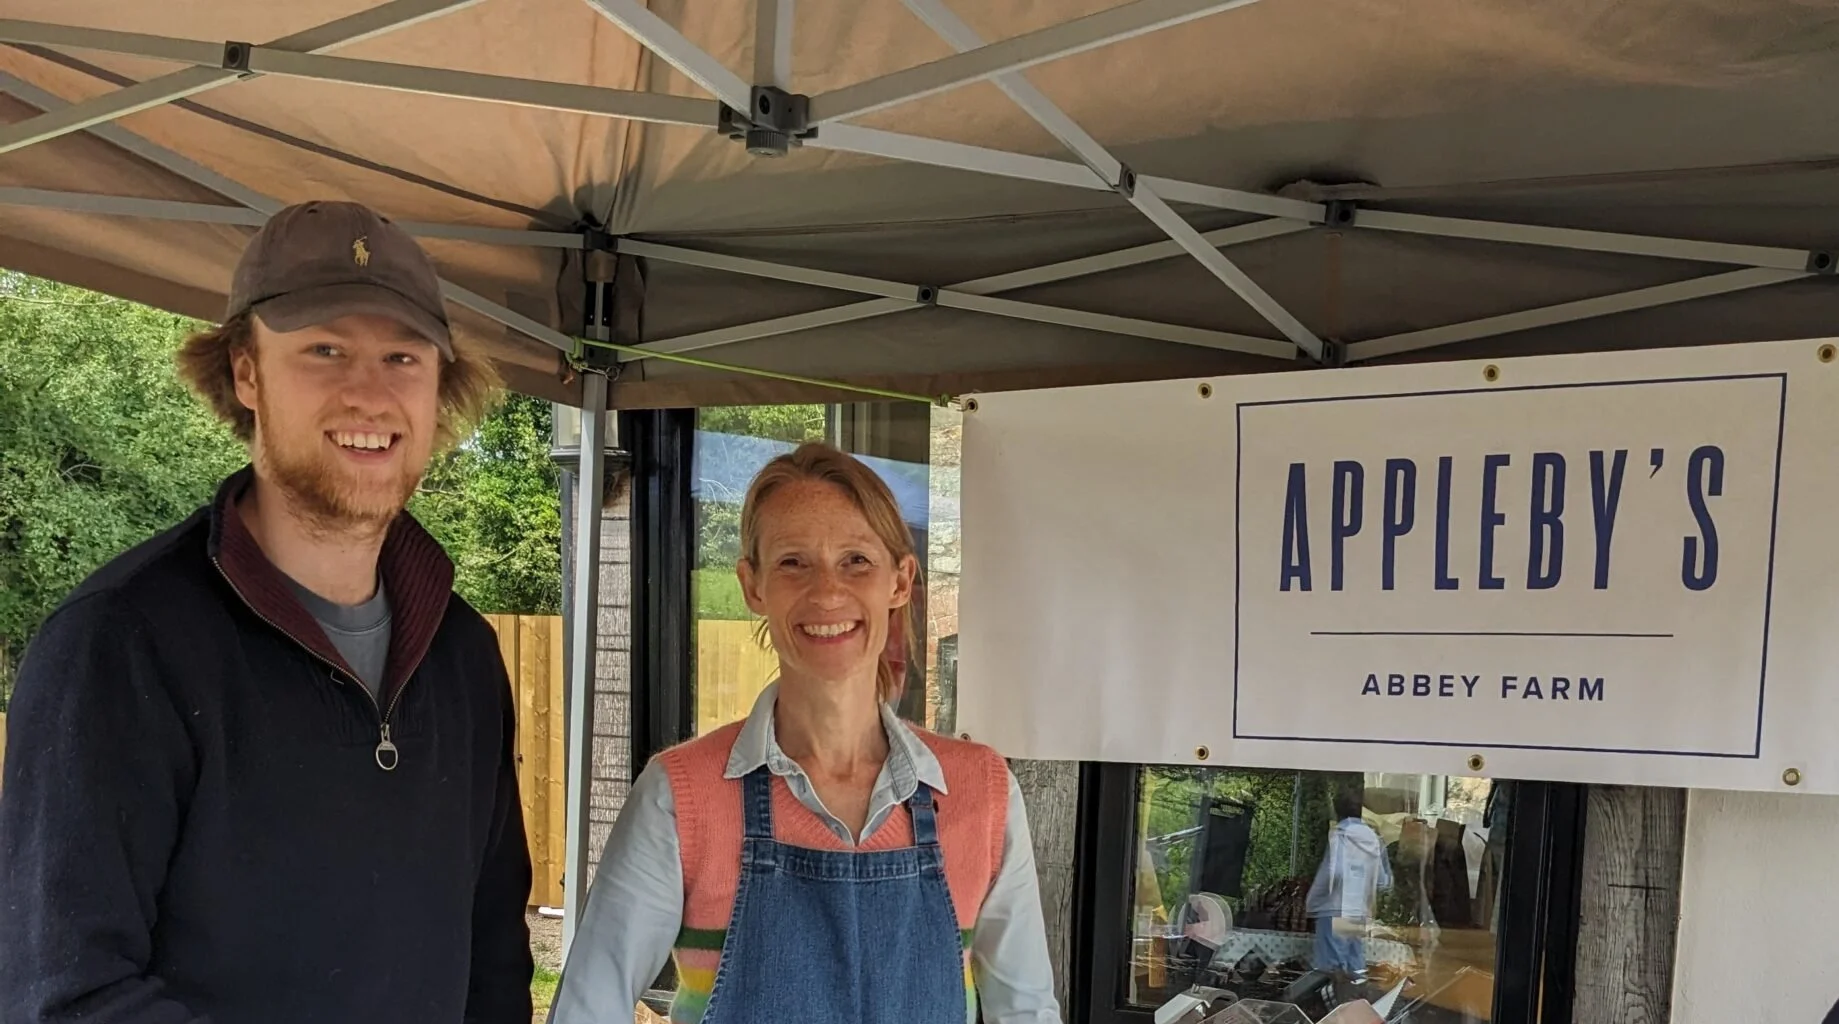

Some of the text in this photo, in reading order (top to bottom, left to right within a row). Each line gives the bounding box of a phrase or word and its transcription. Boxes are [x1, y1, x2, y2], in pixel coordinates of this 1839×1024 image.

[1279, 445, 1725, 592] APPLEBY'S
[1360, 673, 1605, 702] ABBEY FARM
